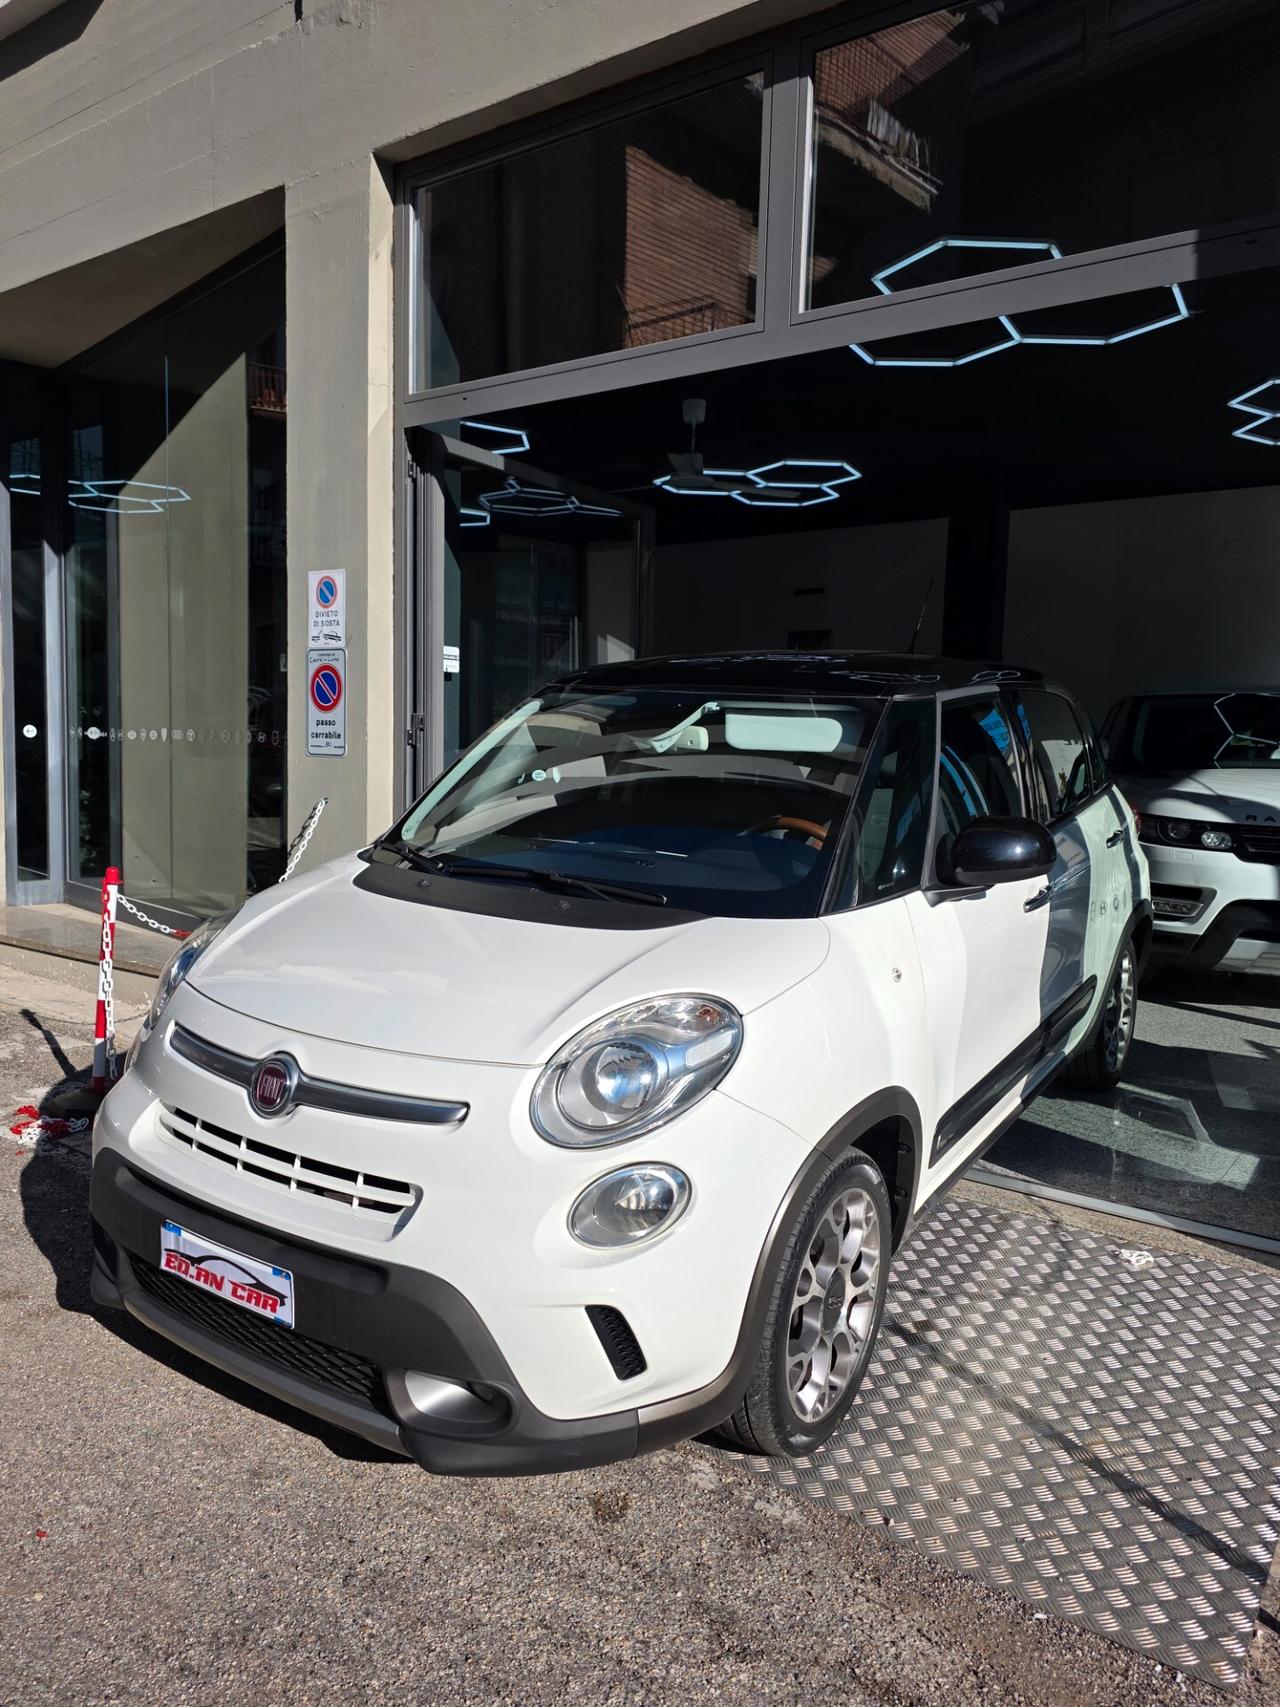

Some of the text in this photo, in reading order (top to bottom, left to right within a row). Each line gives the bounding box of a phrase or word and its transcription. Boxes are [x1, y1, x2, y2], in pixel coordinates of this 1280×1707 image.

[315, 610, 338, 618] DIVIETO
[320, 619, 340, 627] SOSTA
[316, 719, 336, 727] passo
[311, 731, 341, 739] carrabile
[229, 1280, 281, 1314] CAR
